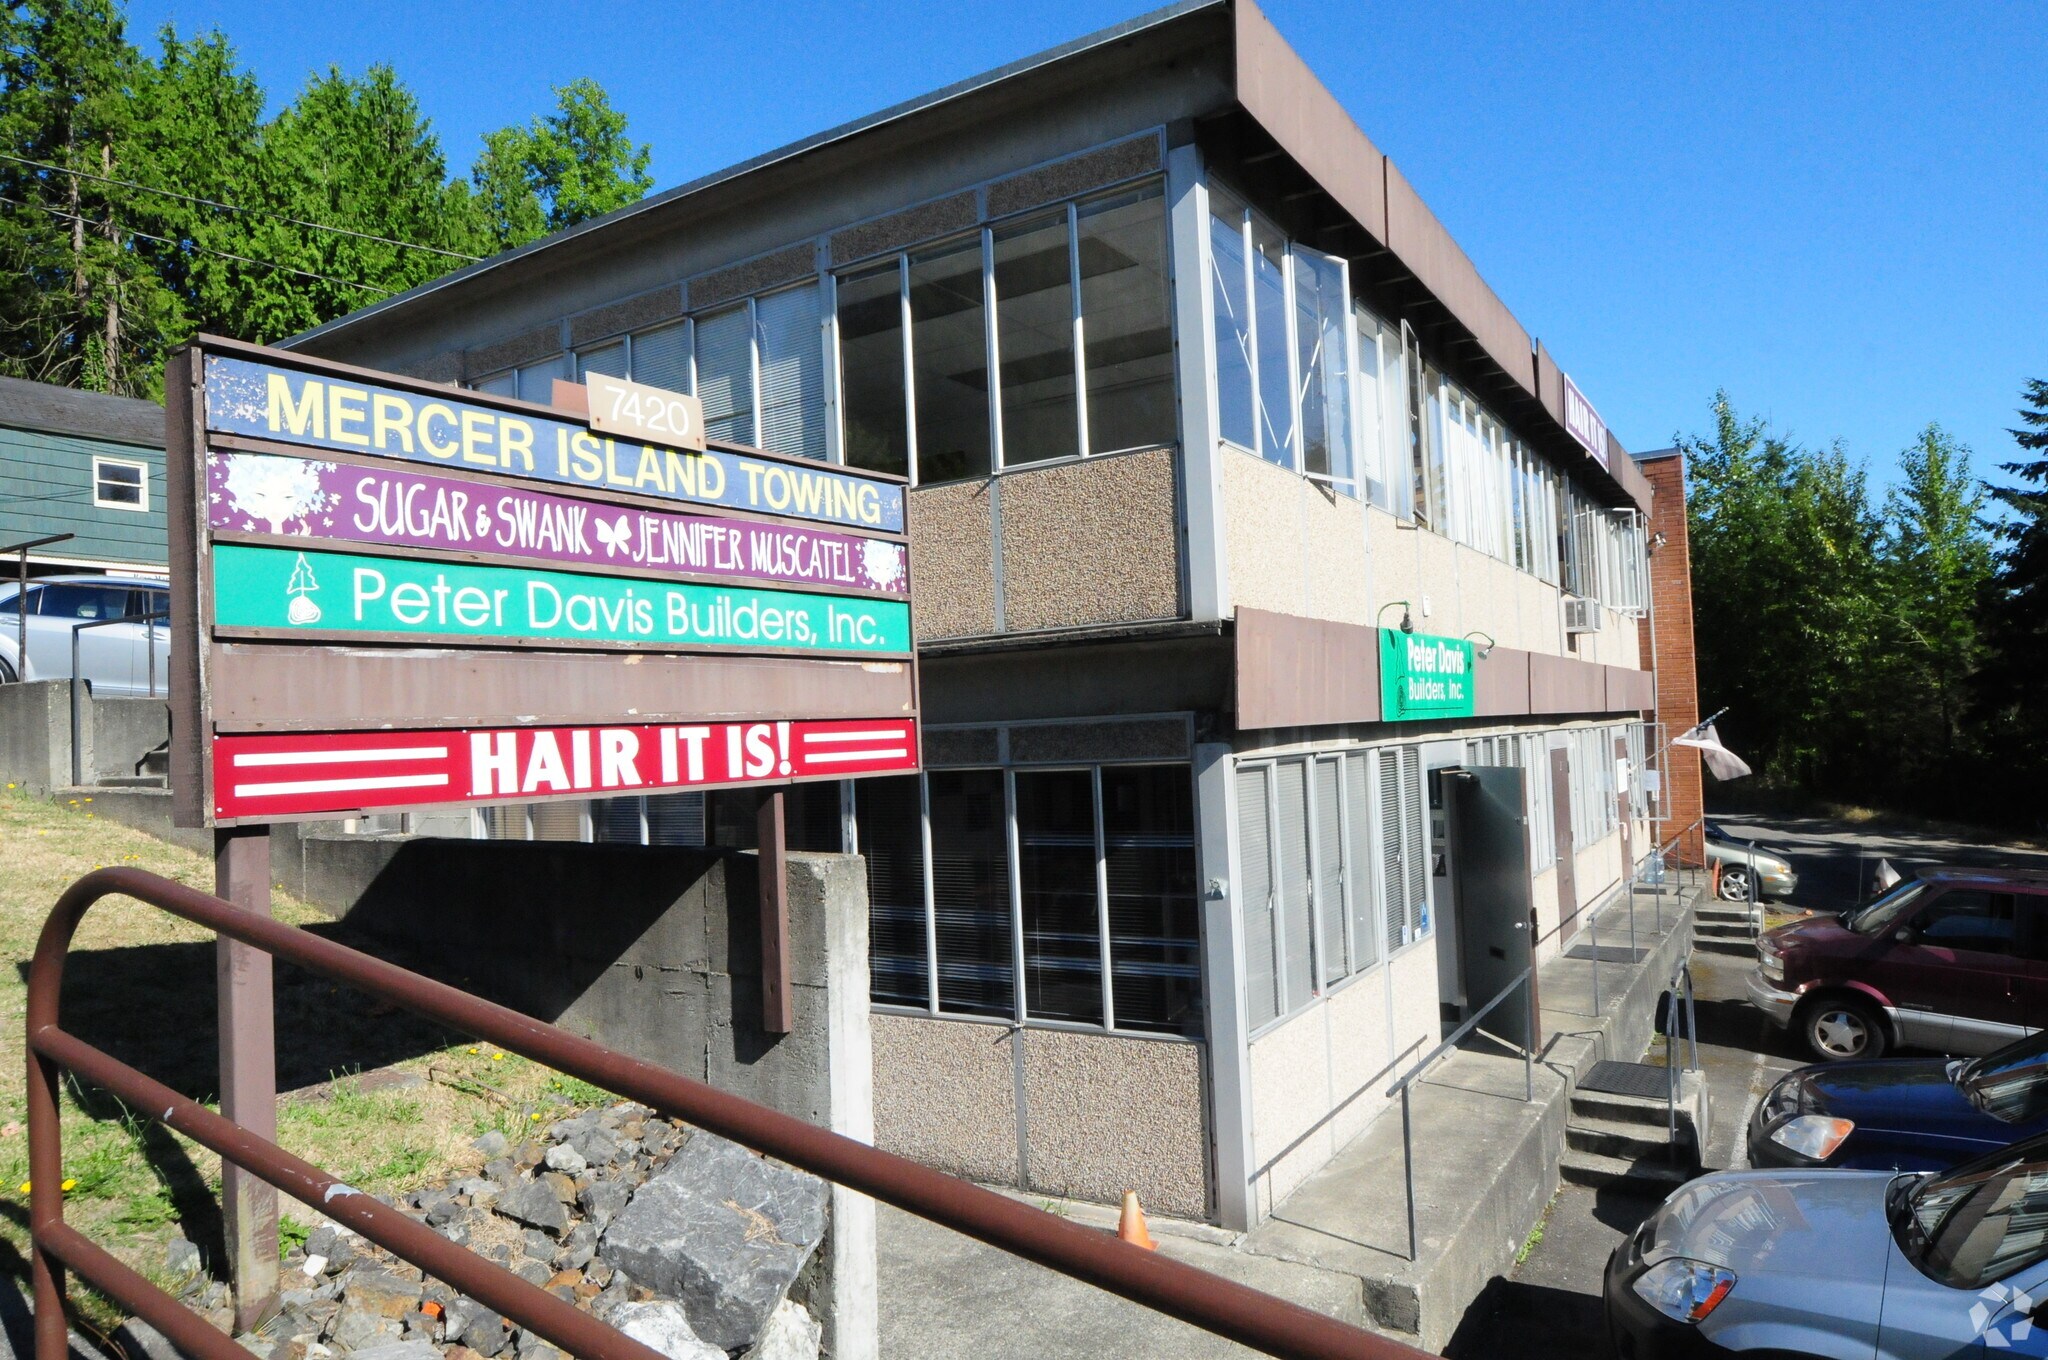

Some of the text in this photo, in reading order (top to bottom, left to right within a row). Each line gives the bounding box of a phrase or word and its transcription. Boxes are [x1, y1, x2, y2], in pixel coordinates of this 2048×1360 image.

[267, 373, 881, 524] MERCER ISLAND TOWING
[605, 385, 690, 437] 7420
[353, 477, 856, 583] SUGAR & SWANK JENNIFER MUSCATEL
[353, 567, 886, 646] Peter Davis Builders, Inc.
[1407, 637, 1465, 675] Peter Davis
[1408, 677, 1464, 702] Builders, Inc.
[470, 721, 792, 796] HAIR IT IS!
